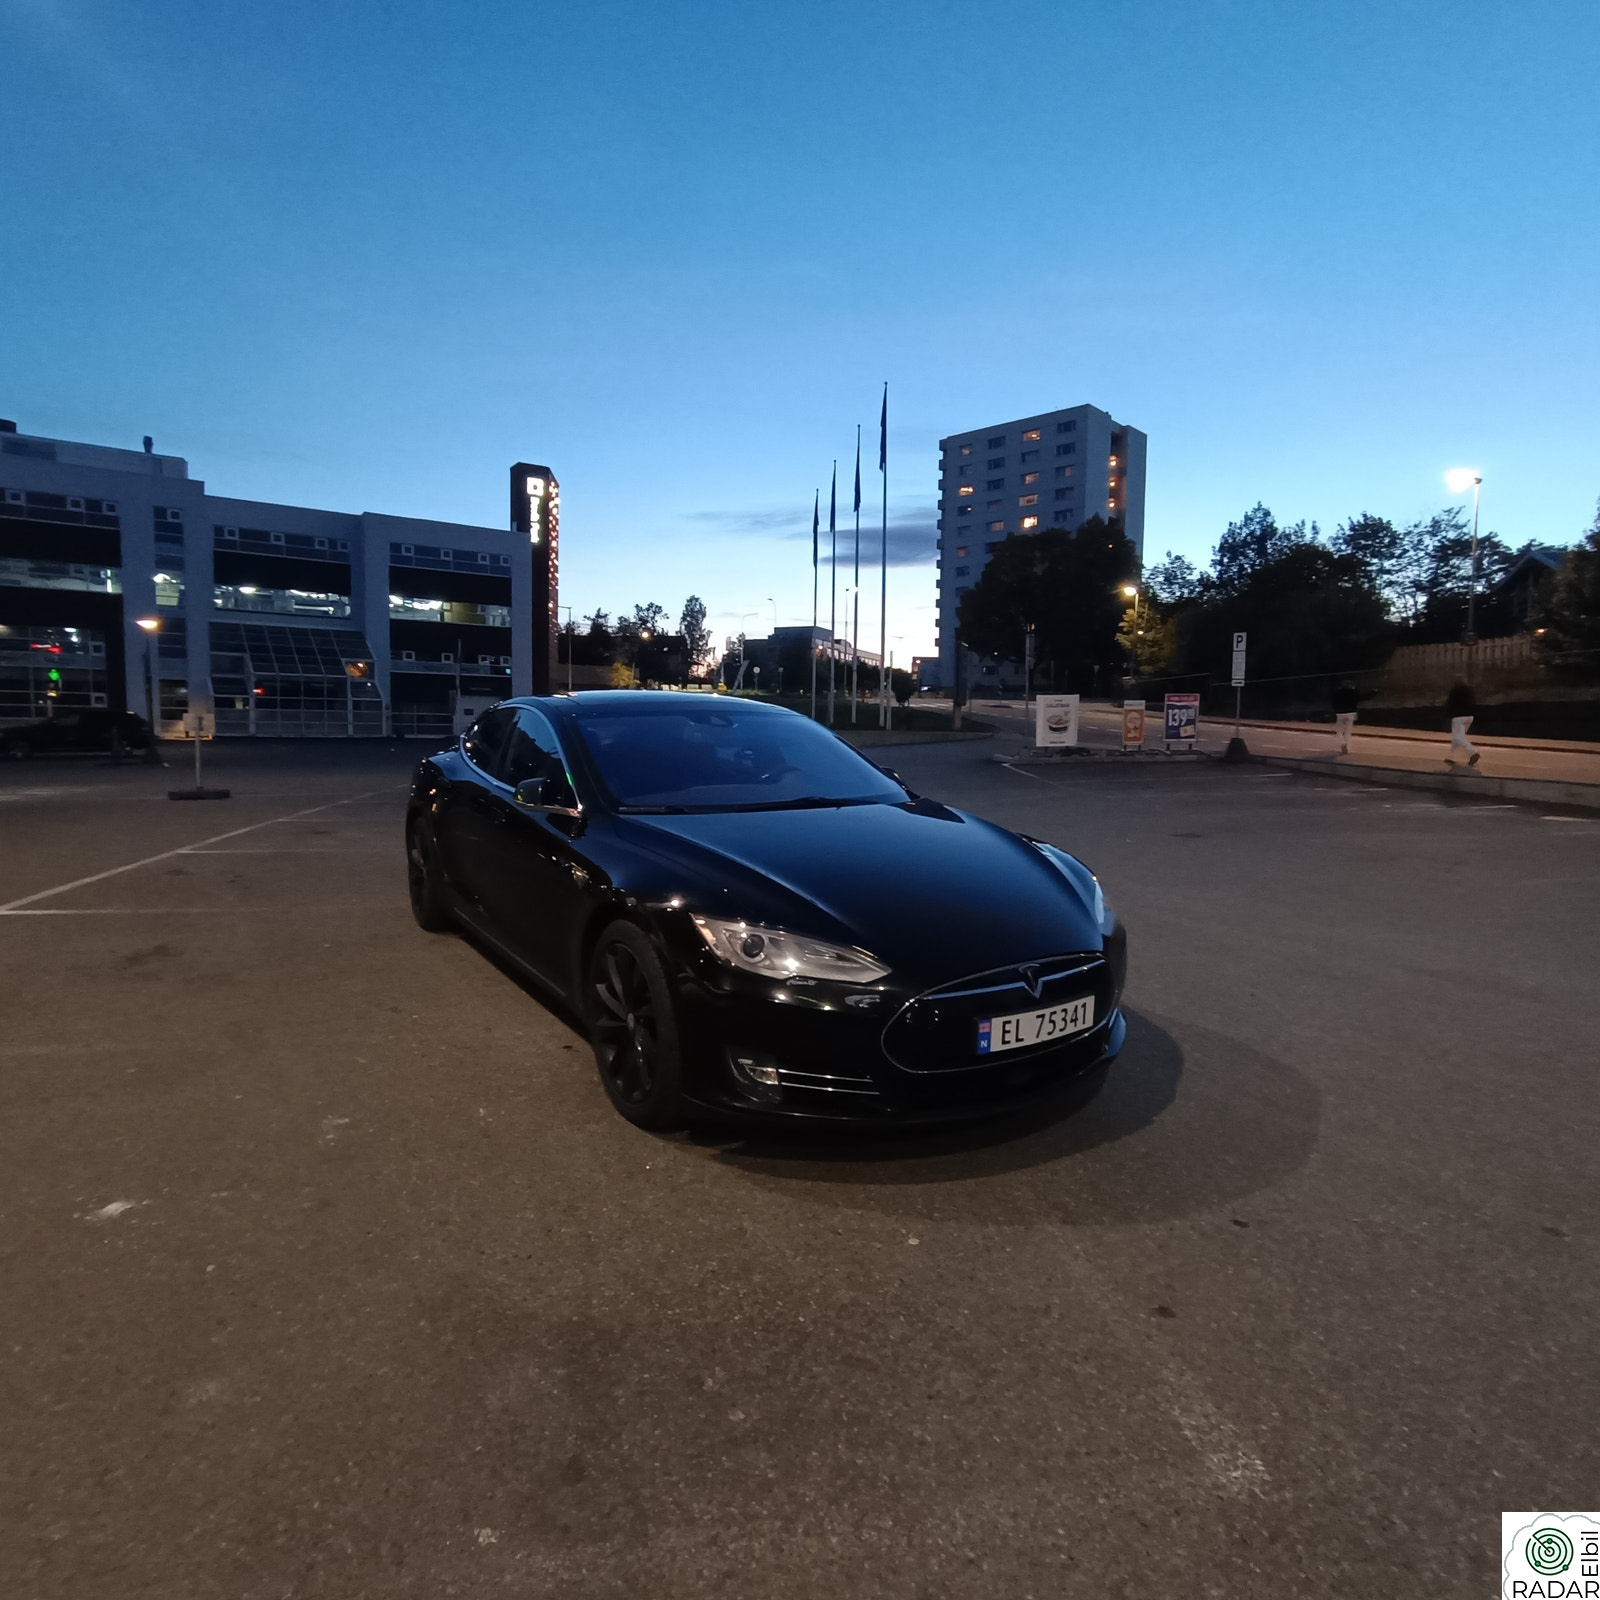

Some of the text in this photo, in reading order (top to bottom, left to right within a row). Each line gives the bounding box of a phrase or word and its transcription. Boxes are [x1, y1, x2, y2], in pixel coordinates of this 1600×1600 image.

[1236, 634, 1244, 648] P
[1168, 708, 1187, 726] 139
[1001, 1002, 1087, 1045] EL 75341
[980, 1040, 988, 1048] N
